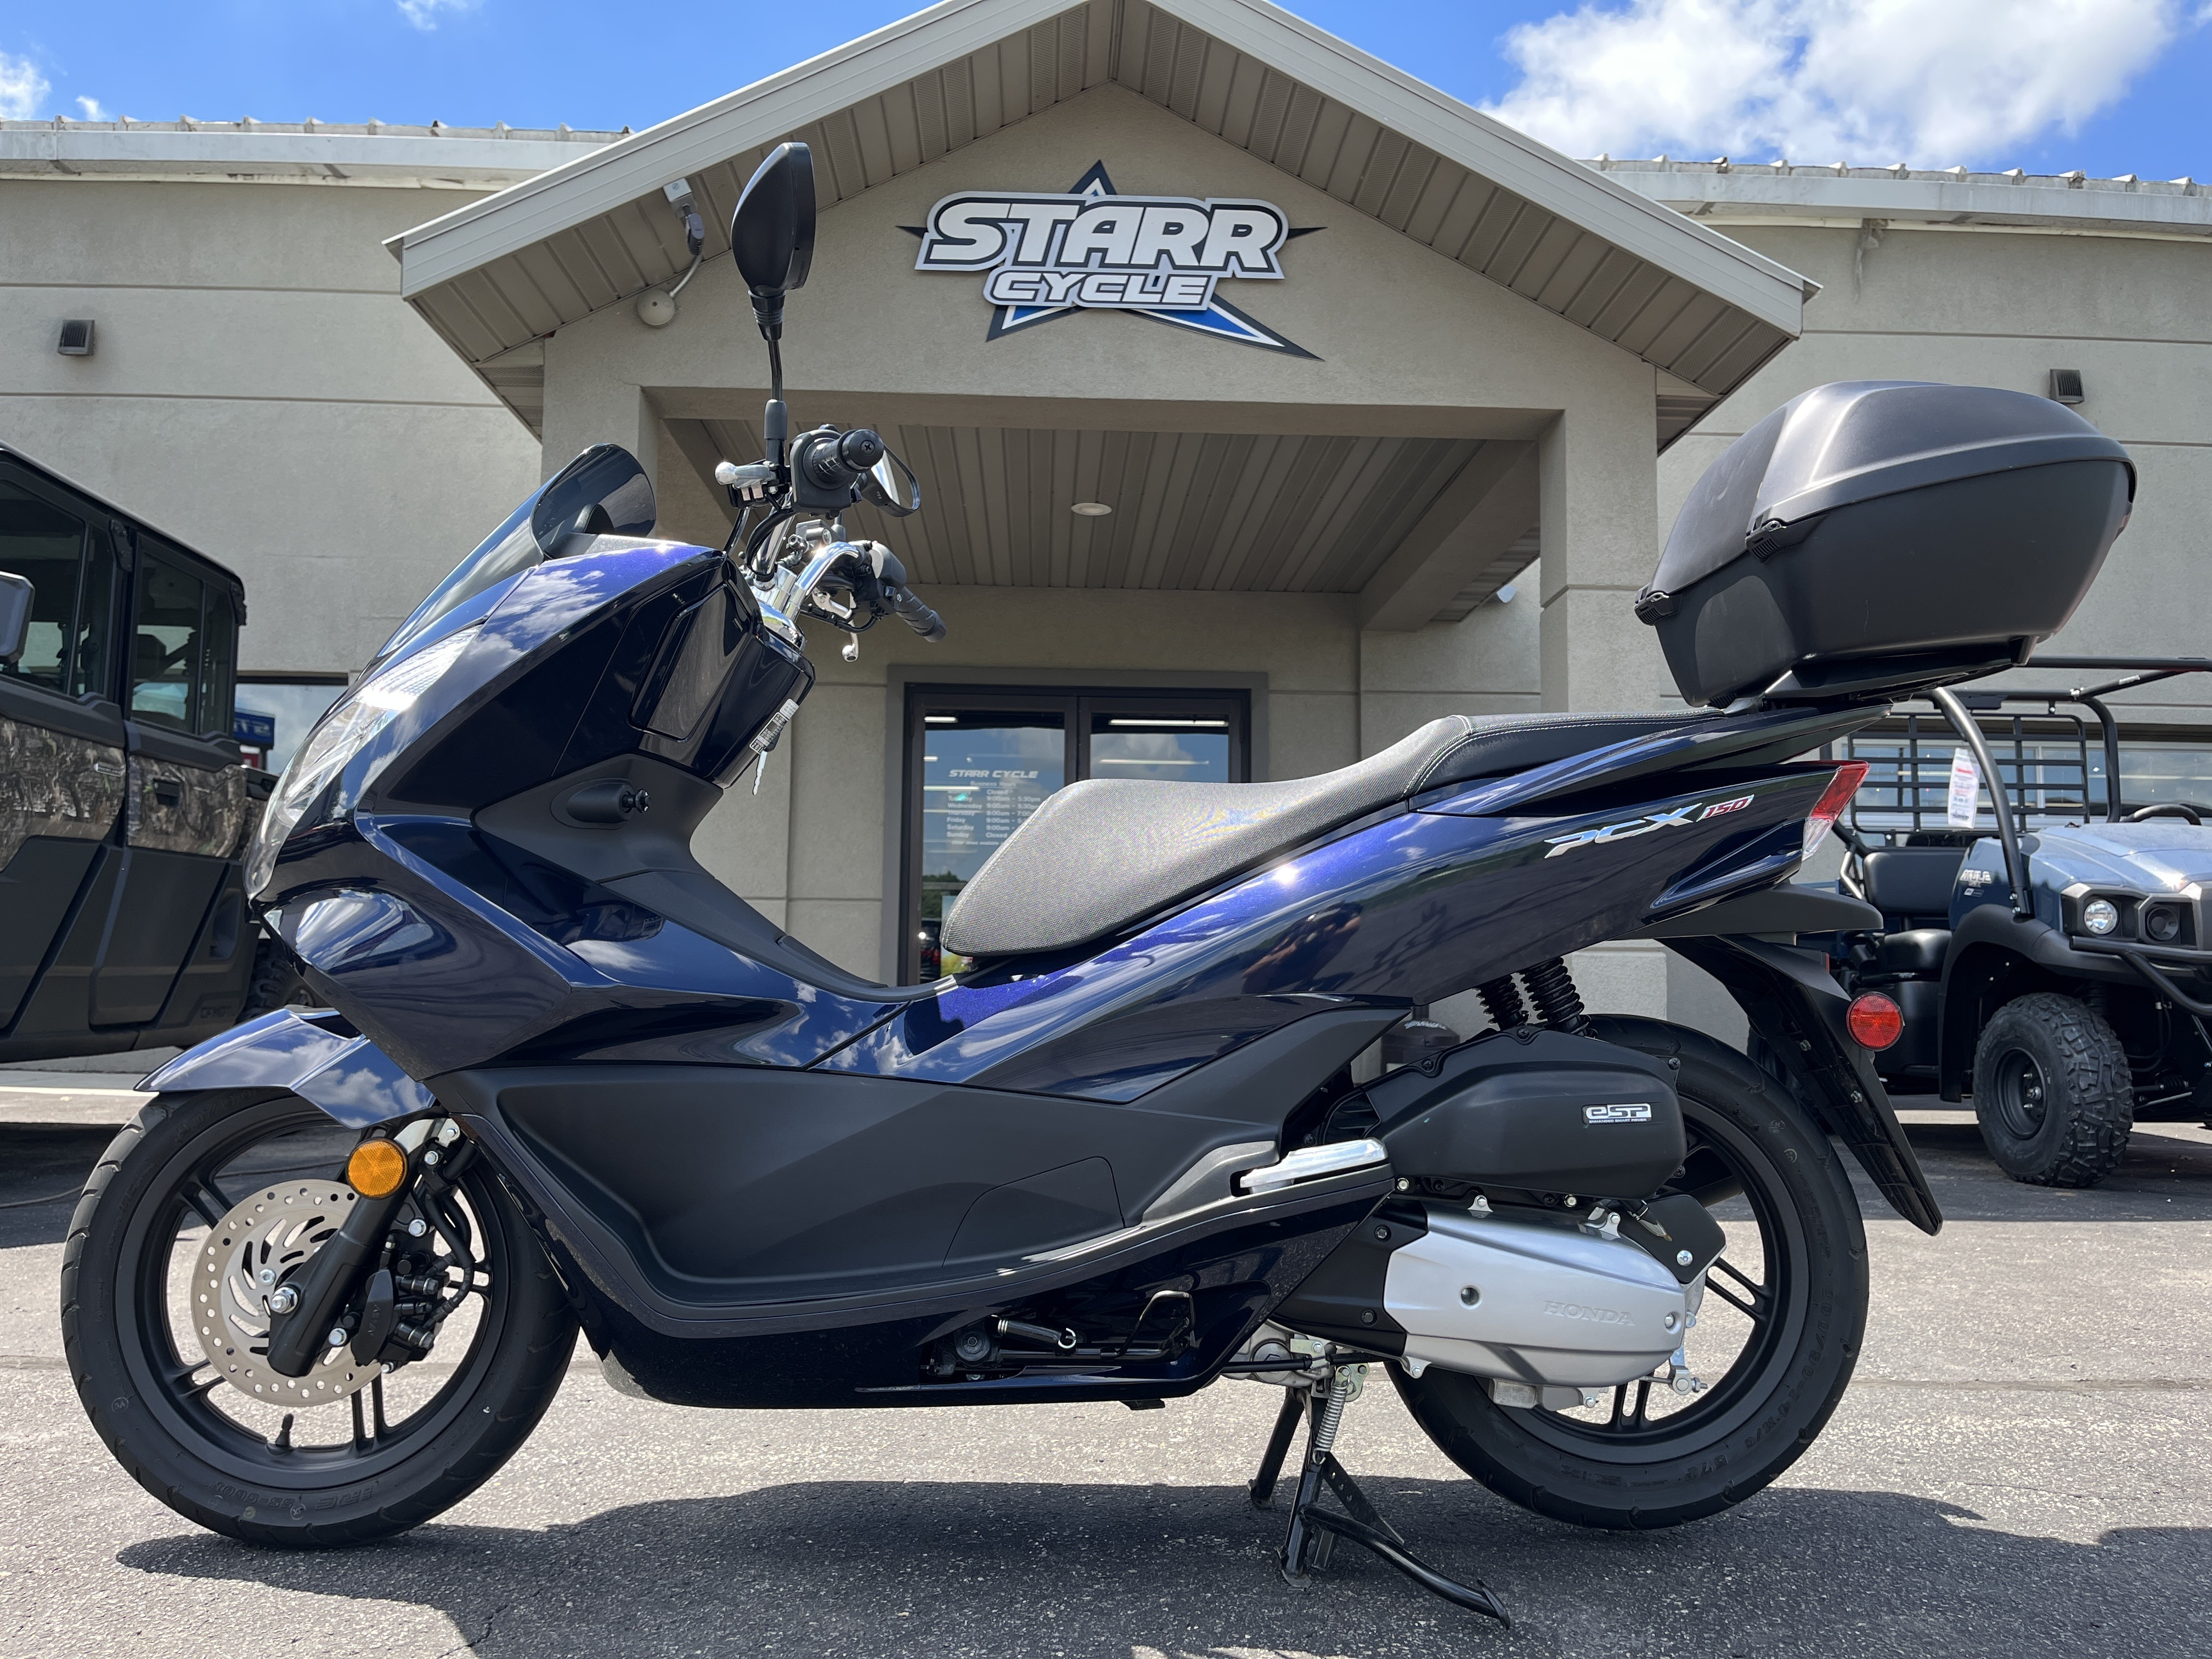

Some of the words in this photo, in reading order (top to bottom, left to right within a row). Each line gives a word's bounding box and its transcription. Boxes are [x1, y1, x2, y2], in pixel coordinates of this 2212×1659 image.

[924, 198, 1283, 272] STARR
[990, 270, 1211, 307] CYCLE
[992, 770, 1039, 778] CYCLE
[1544, 803, 1702, 859] PCX
[1702, 797, 1751, 820] 150
[1959, 869, 1992, 884] MULE
[1543, 1300, 1636, 1326] HONDA
